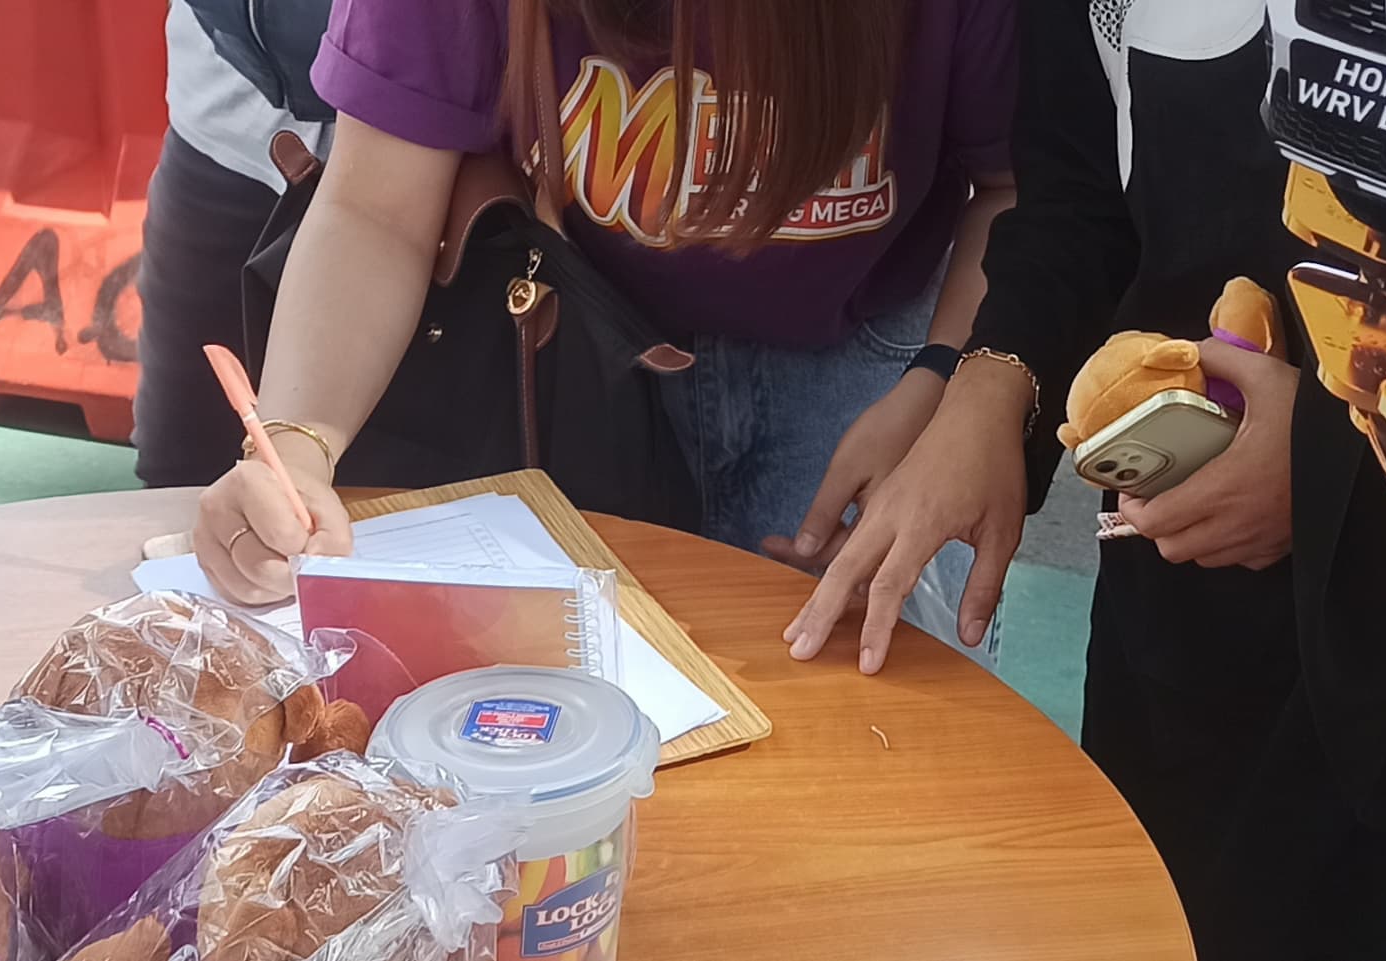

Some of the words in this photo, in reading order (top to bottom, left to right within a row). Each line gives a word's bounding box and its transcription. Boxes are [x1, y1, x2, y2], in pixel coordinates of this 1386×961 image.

[1298, 78, 1375, 123] WRV
[811, 193, 886, 224] MEGA
[536, 892, 599, 927] LOCK
